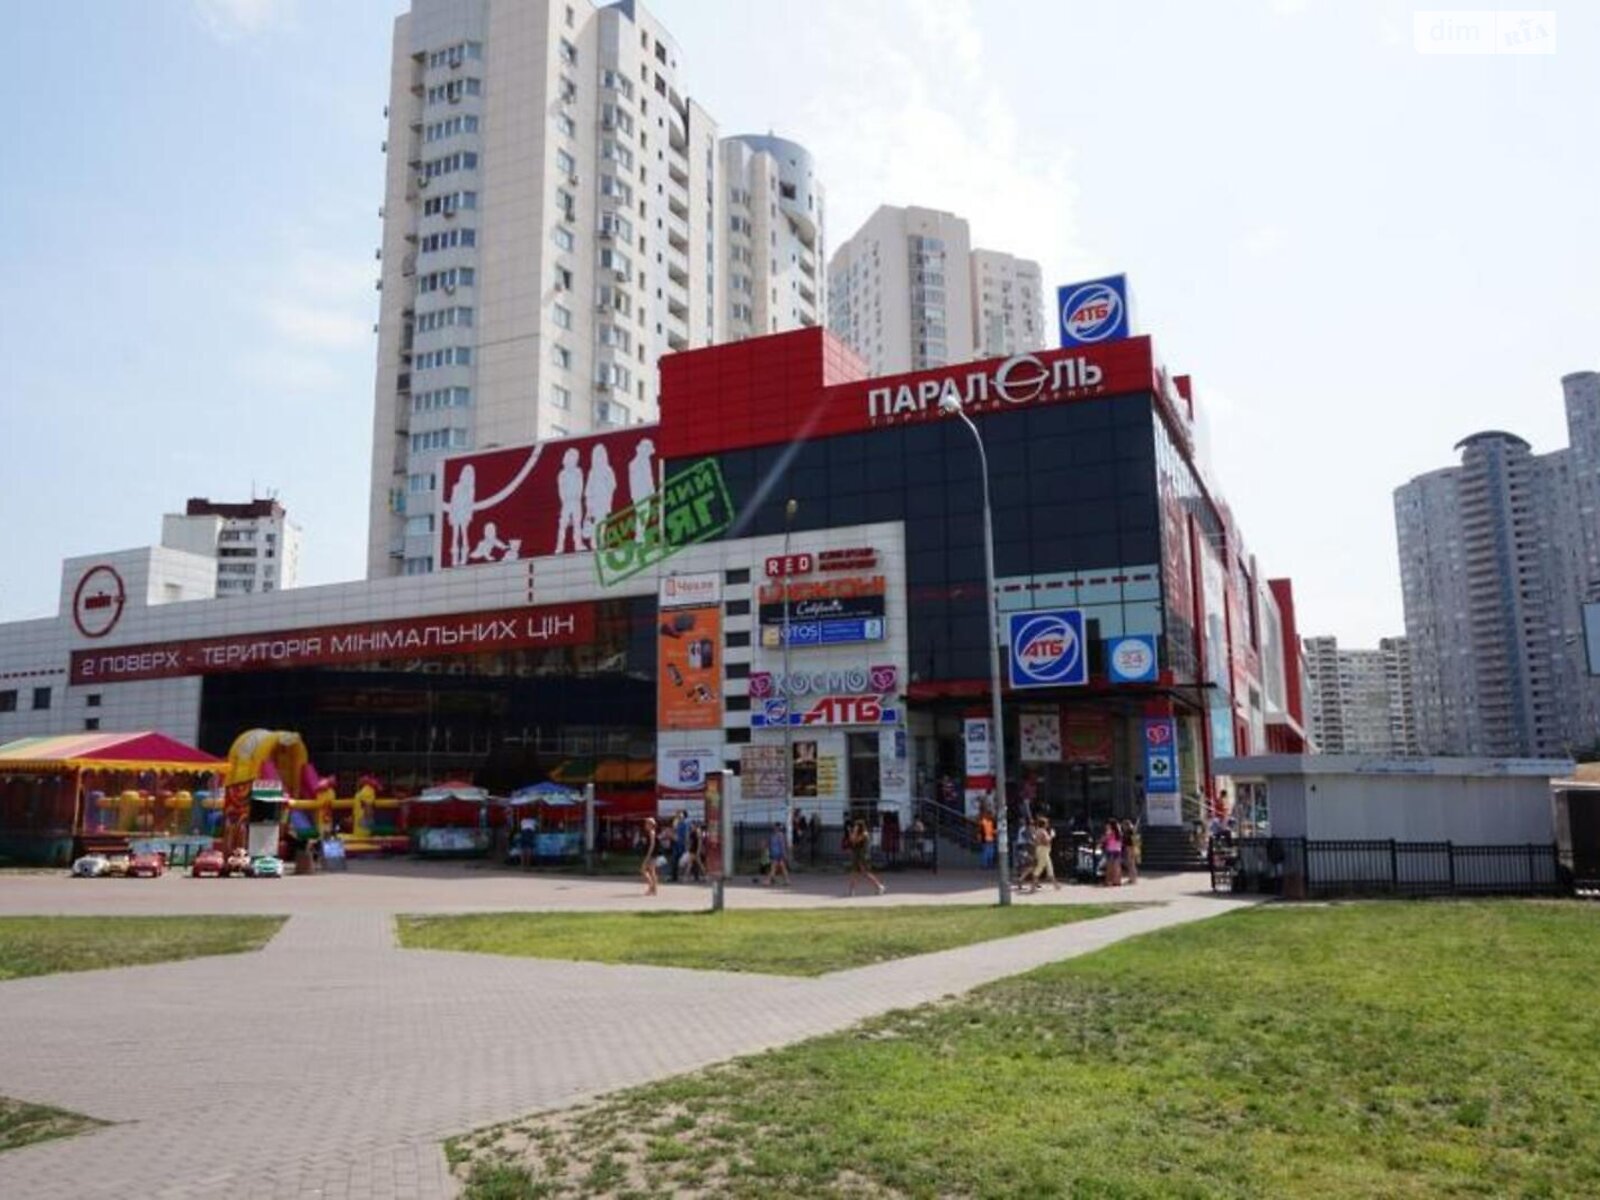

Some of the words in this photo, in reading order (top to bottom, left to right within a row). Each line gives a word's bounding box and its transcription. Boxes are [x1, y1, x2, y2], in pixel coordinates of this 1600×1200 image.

[1071, 303, 1108, 323] АТБ
[82, 660, 95, 675] 2
[101, 652, 180, 673] ПОВЕРХ
[202, 638, 321, 665] ТЕРИТОРІЯ
[331, 619, 516, 653] МІНІМАЛЬНИХ
[528, 614, 575, 640] ЦІН
[1024, 639, 1063, 658] АТБ
[803, 694, 881, 725] АТБ
